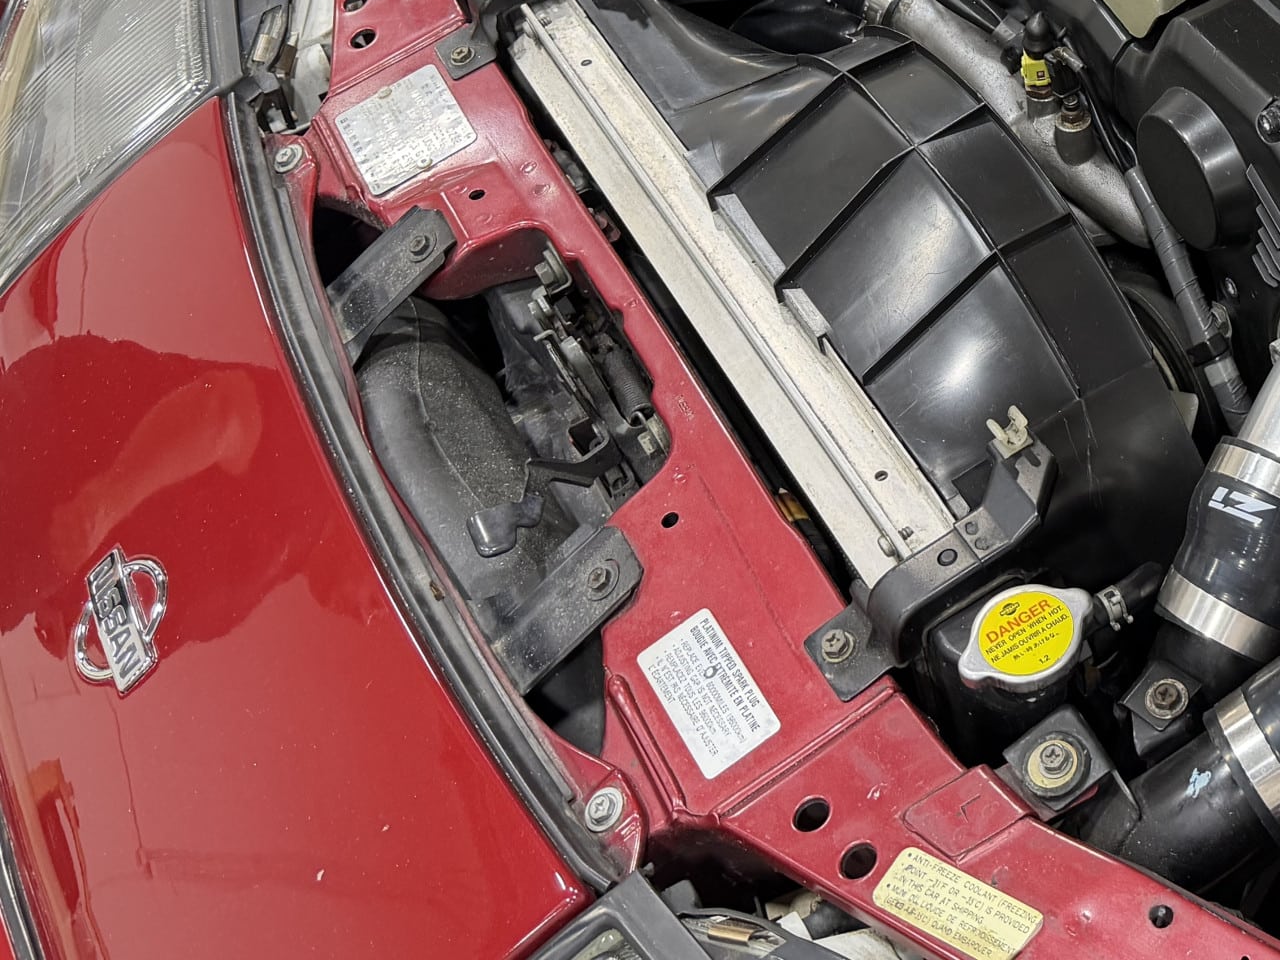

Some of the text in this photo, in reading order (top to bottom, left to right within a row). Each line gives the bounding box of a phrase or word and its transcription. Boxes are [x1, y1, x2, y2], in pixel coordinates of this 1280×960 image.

[89, 555, 142, 680] NISSAN
[985, 599, 1052, 644] DANGER
[688, 625, 708, 649] BOUGIE
[985, 640, 1007, 655] NEVER
[1008, 628, 1027, 642] OPEN
[1029, 615, 1047, 629] WHEN
[991, 656, 1002, 664] NE
[1018, 631, 1042, 646] OUVRIR
[679, 640, 699, 665] REPLACE
[698, 617, 760, 707] PLATINUM TIPPED SPARK PLUG
[702, 646, 717, 664] AVEC
[663, 652, 687, 683] REMPLACEZ
[682, 682, 696, 698] TOUS
[690, 696, 703, 710] LES
[669, 681, 681, 694] PAS
[671, 646, 732, 738] ADJUSTING GAP IS NOT NECESSARY
[732, 695, 744, 707] EN
[737, 704, 761, 733] PLATINE
[903, 862, 927, 880] POINT
[948, 885, 960, 897] OR
[984, 905, 993, 915] IS
[992, 909, 1031, 935] PROVIDED
[907, 879, 924, 893] THIS
[923, 887, 940, 901] CAR
[938, 895, 951, 907] AT
[911, 853, 1038, 925] ANTI-FREEZE COOLANT (FREEZING
[930, 919, 953, 936] QUAND
[945, 912, 956, 923] DE
